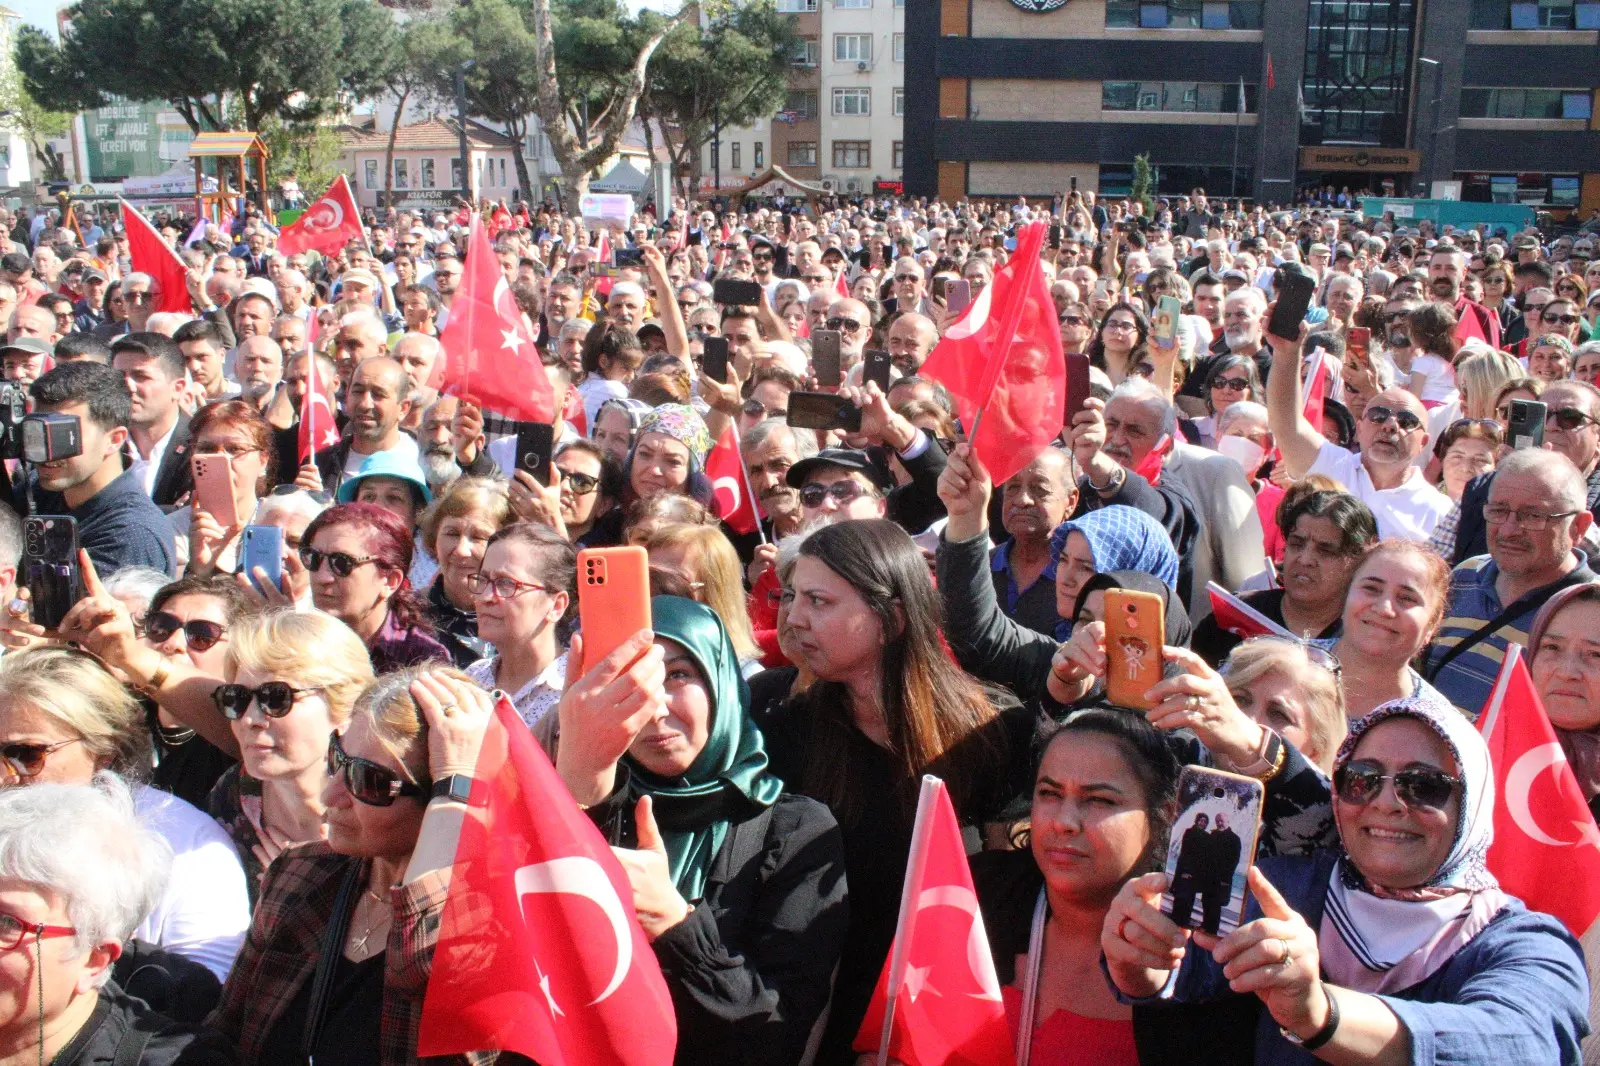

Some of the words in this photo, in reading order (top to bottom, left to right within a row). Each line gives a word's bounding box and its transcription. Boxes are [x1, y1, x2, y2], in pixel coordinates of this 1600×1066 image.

[95, 124, 109, 137] EFT
[100, 137, 127, 152] ÜCRETİ
[129, 139, 147, 152] YOK
